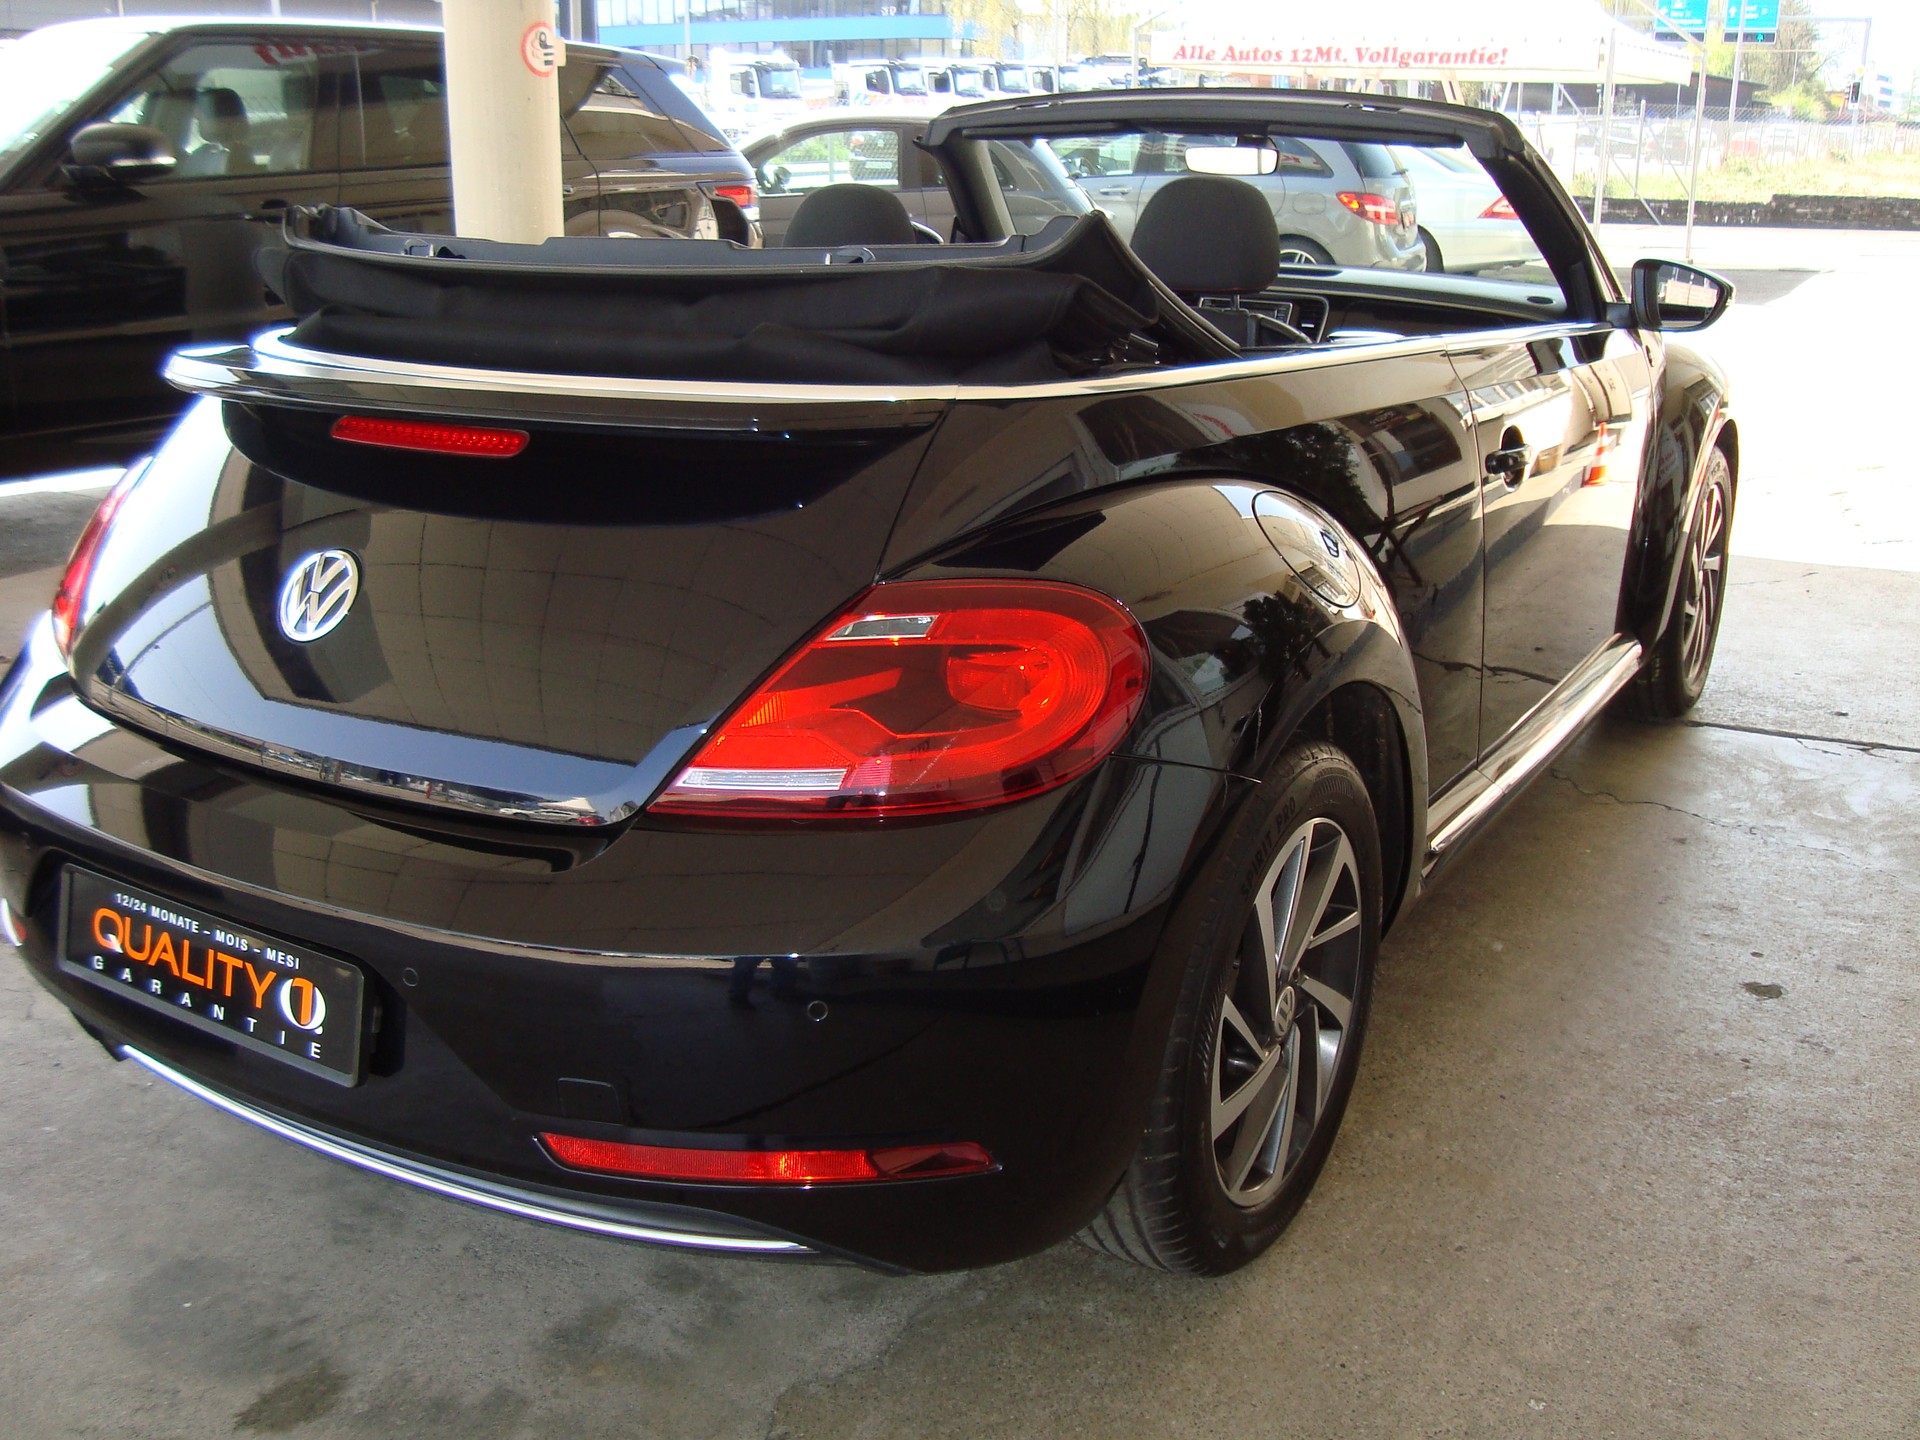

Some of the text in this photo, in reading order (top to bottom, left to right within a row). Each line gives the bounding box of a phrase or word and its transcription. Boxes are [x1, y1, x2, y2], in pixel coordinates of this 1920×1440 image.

[1172, 45, 1508, 68] Alle Autos 12Mt. Vollgarantie!
[93, 907, 277, 1009] QUALITY
[114, 893, 147, 914] 12/24
[151, 905, 200, 934] MONATE
[216, 929, 248, 951] MOIS
[266, 947, 299, 970] MESI
[93, 955, 322, 1059] GARANTIE
